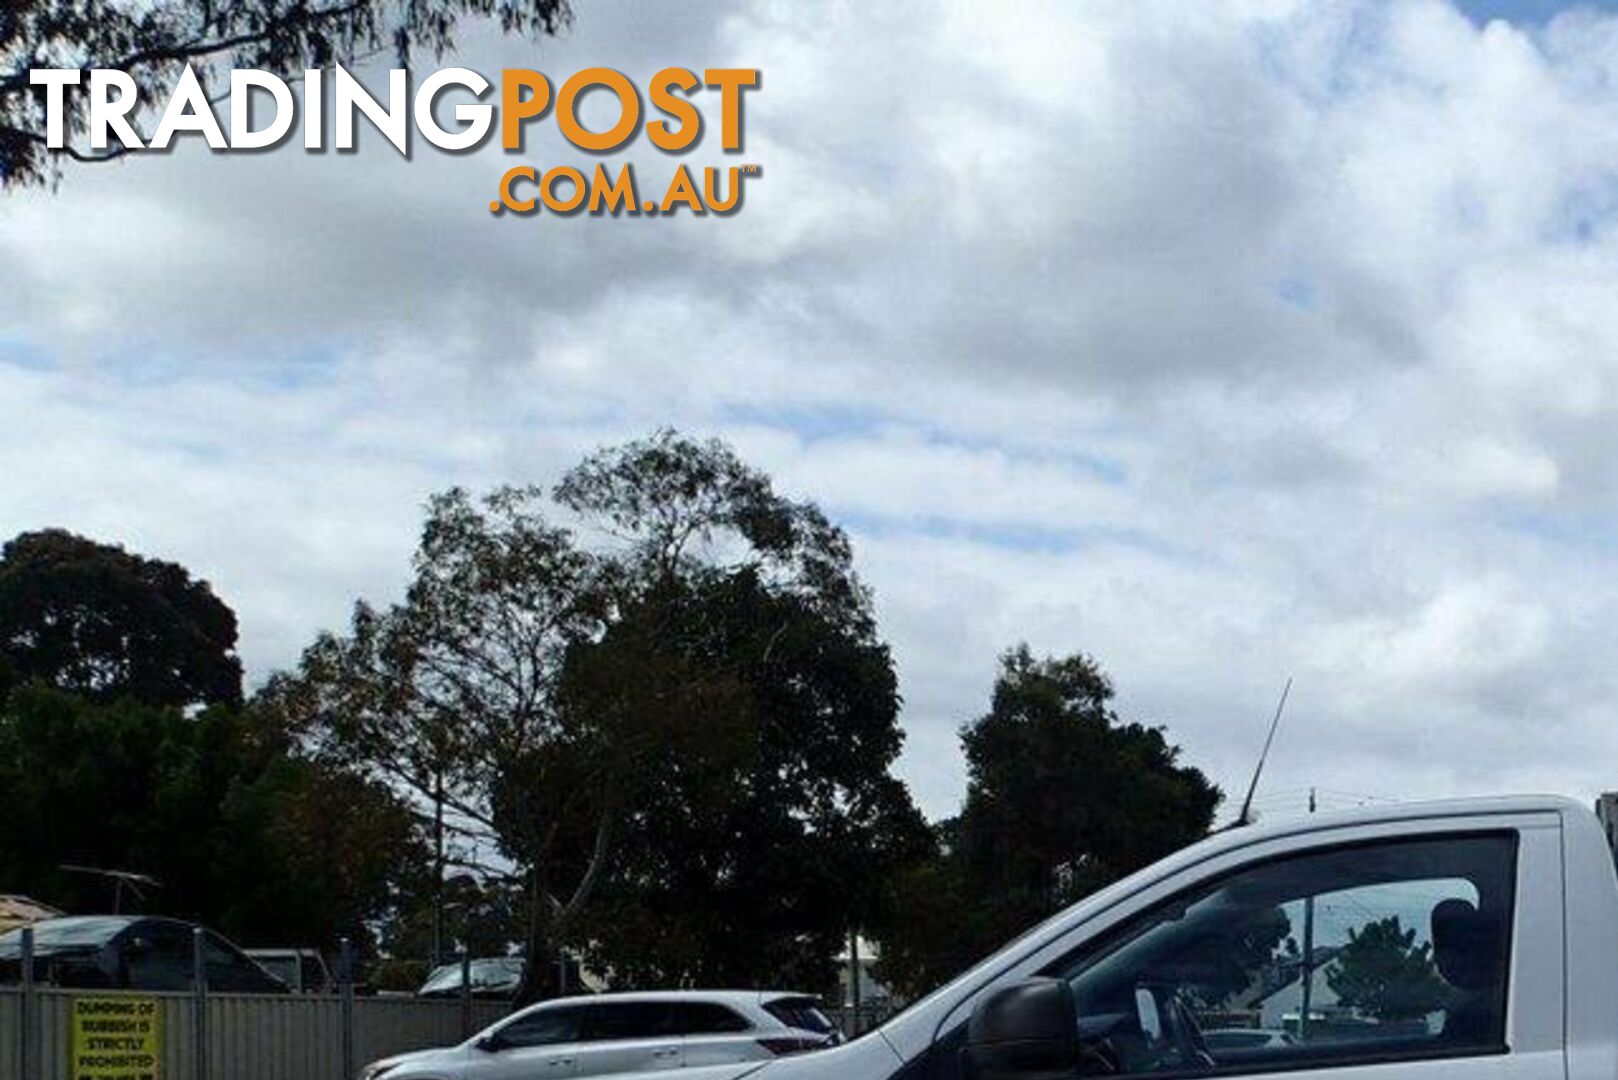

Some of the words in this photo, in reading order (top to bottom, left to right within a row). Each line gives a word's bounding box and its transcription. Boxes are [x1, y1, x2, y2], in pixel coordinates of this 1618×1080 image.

[77, 1001, 135, 1015] DUMPING
[138, 1002, 155, 1015] OF
[81, 1020, 136, 1033] RUBBISH
[138, 1020, 150, 1033] IS
[87, 1037, 144, 1050] STRICTLY
[79, 1054, 154, 1068] PROHIBITED
